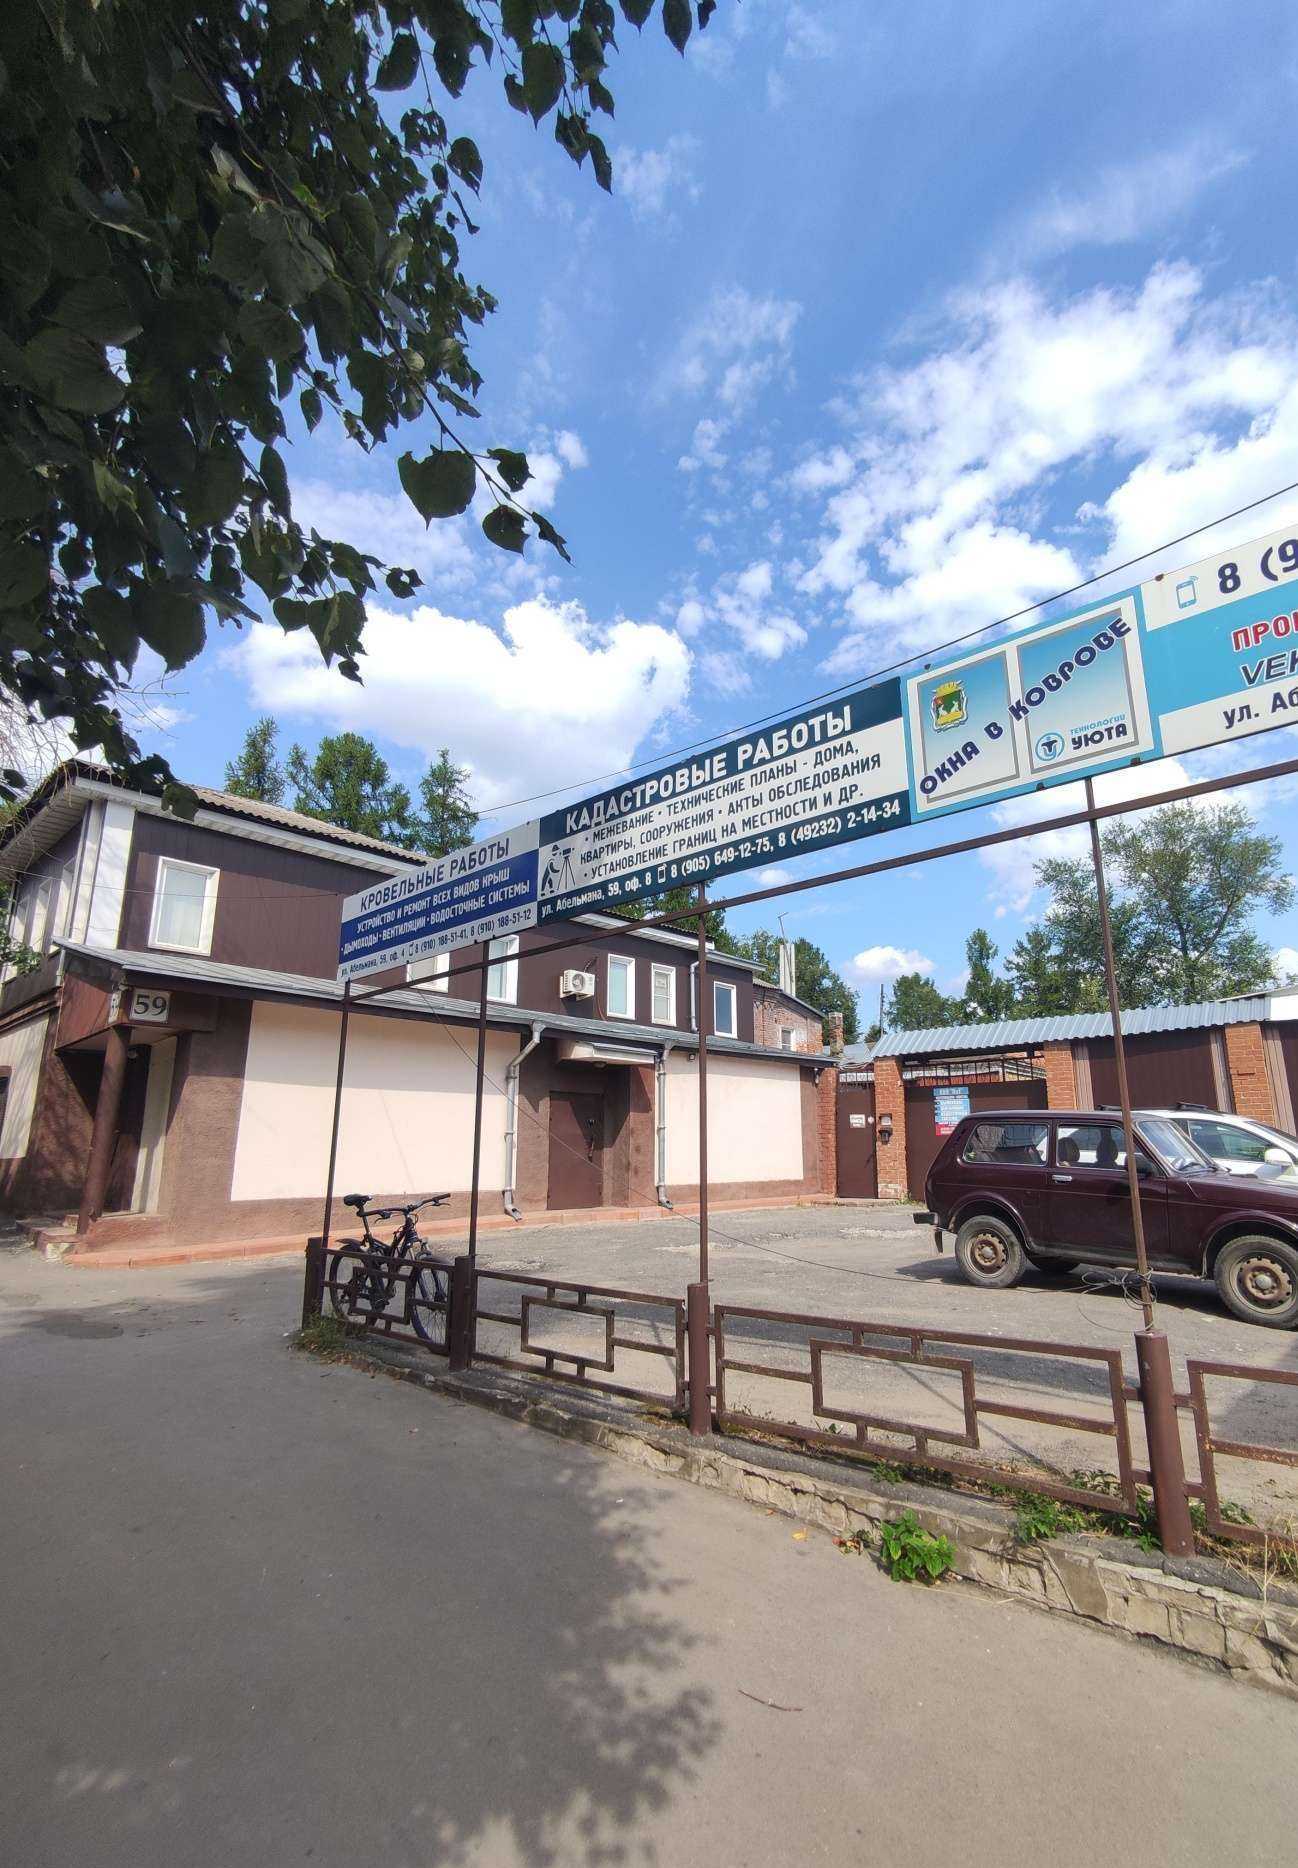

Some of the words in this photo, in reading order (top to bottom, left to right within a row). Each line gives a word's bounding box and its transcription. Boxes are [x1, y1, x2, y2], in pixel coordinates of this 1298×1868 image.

[1218, 562, 1241, 594] 8
[1233, 611, 1298, 651] ПРО
[920, 741, 980, 795] ОКНА
[984, 721, 1004, 740] В
[1008, 617, 1132, 721] КОВРОВЕ
[1071, 723, 1128, 750] УЮТА
[1223, 704, 1260, 729] ул.
[566, 752, 727, 834] КАДАСТРОВЫЕ
[737, 705, 851, 770] РАБОТЫ
[592, 810, 655, 843] МЕЖЕВАНИЕ
[667, 777, 745, 817] ТЕХНИЧЕСКИЕ
[750, 759, 797, 788] ПЛАНЫ
[813, 740, 858, 769] ДОМА,
[580, 836, 636, 865] КВАРТИРЫ,
[640, 808, 714, 845] СООРУЖЕНИЯ
[728, 792, 763, 816] АКТЫ
[769, 753, 881, 801] ОБСЛЕДОВАНИЯ
[591, 844, 669, 880] УСТАНОВЛЕНИЕ
[673, 828, 717, 853] ГРАНИЦ
[721, 823, 737, 839] НА
[742, 793, 823, 833] МЕСТНОСТИ
[824, 790, 833, 806] И
[838, 783, 863, 804] ДР.
[360, 864, 445, 912] КРОВЕЛЬНЫЕ
[450, 838, 510, 877] РАБОТЫ
[541, 905, 554, 918] ул.
[556, 888, 605, 912] Абельмана,
[608, 881, 622, 896] 59,
[625, 875, 642, 893] оф.
[645, 871, 652, 886] 8
[671, 863, 678, 878] 8
[681, 854, 710, 877] (905)
[714, 837, 773, 865] 649-12-75,
[778, 831, 786, 847] 8
[791, 816, 842, 844] (49232)
[847, 799, 901, 828] 2-14-34
[357, 910, 396, 934] УСТРОЙСТВО
[397, 907, 402, 918] И
[403, 896, 431, 917] РЕМОНТ
[432, 888, 452, 907] ВСЕХ
[453, 878, 480, 899] ВИДОВ
[482, 867, 510, 888] КРЫШ
[382, 915, 426, 941] ВЕНТИЛЯЦИИ
[430, 895, 486, 925] ВОДОСТОЧНЫЕ
[488, 880, 530, 905] СИСТЕМЫ
[477, 919, 494, 936] (910)
[498, 908, 531, 927] 188-51-12
[134, 993, 167, 1016] 59
